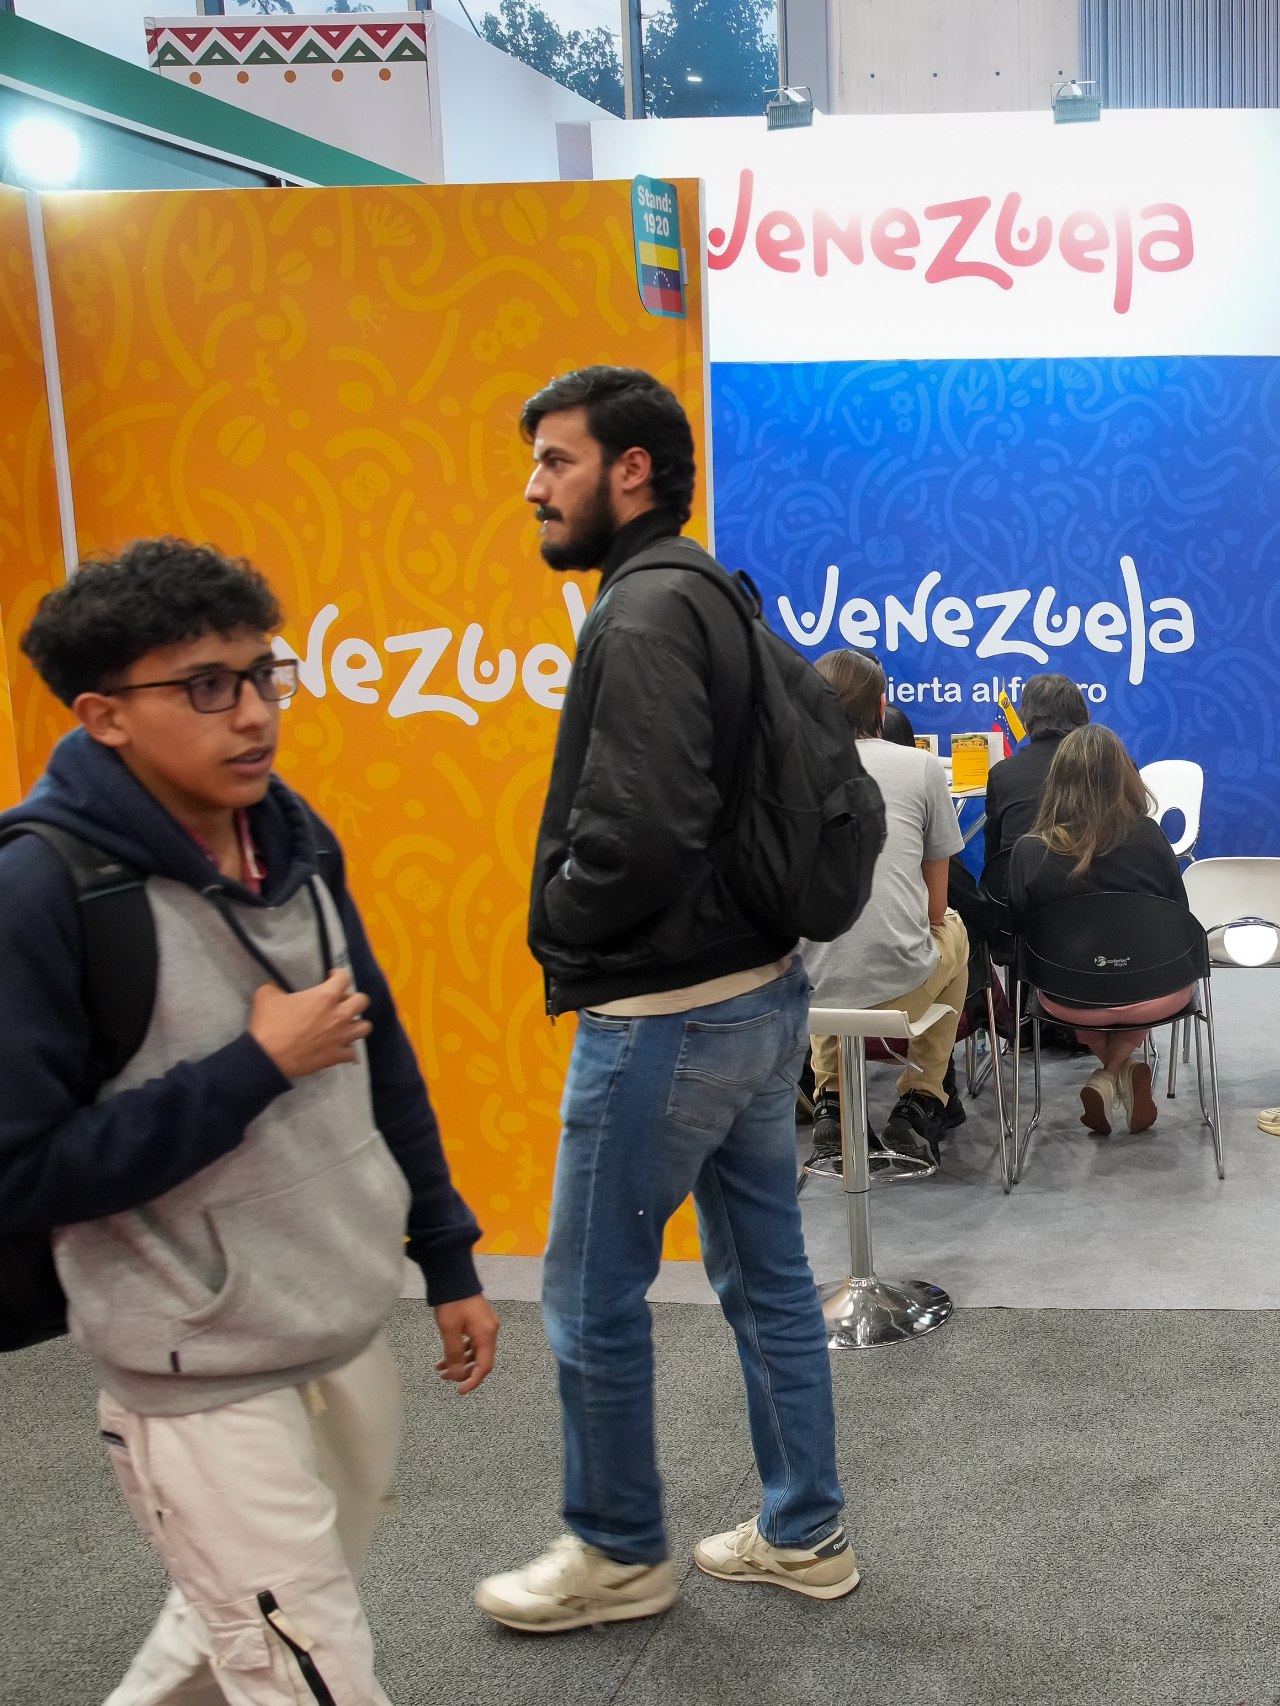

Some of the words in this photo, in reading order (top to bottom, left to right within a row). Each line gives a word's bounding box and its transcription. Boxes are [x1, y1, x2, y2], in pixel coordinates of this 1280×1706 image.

[637, 184, 673, 214] Stand:
[643, 212, 670, 238] 1920
[777, 555, 1196, 686] Venezuela
[887, 676, 962, 703] ierta
[972, 675, 999, 703] al
